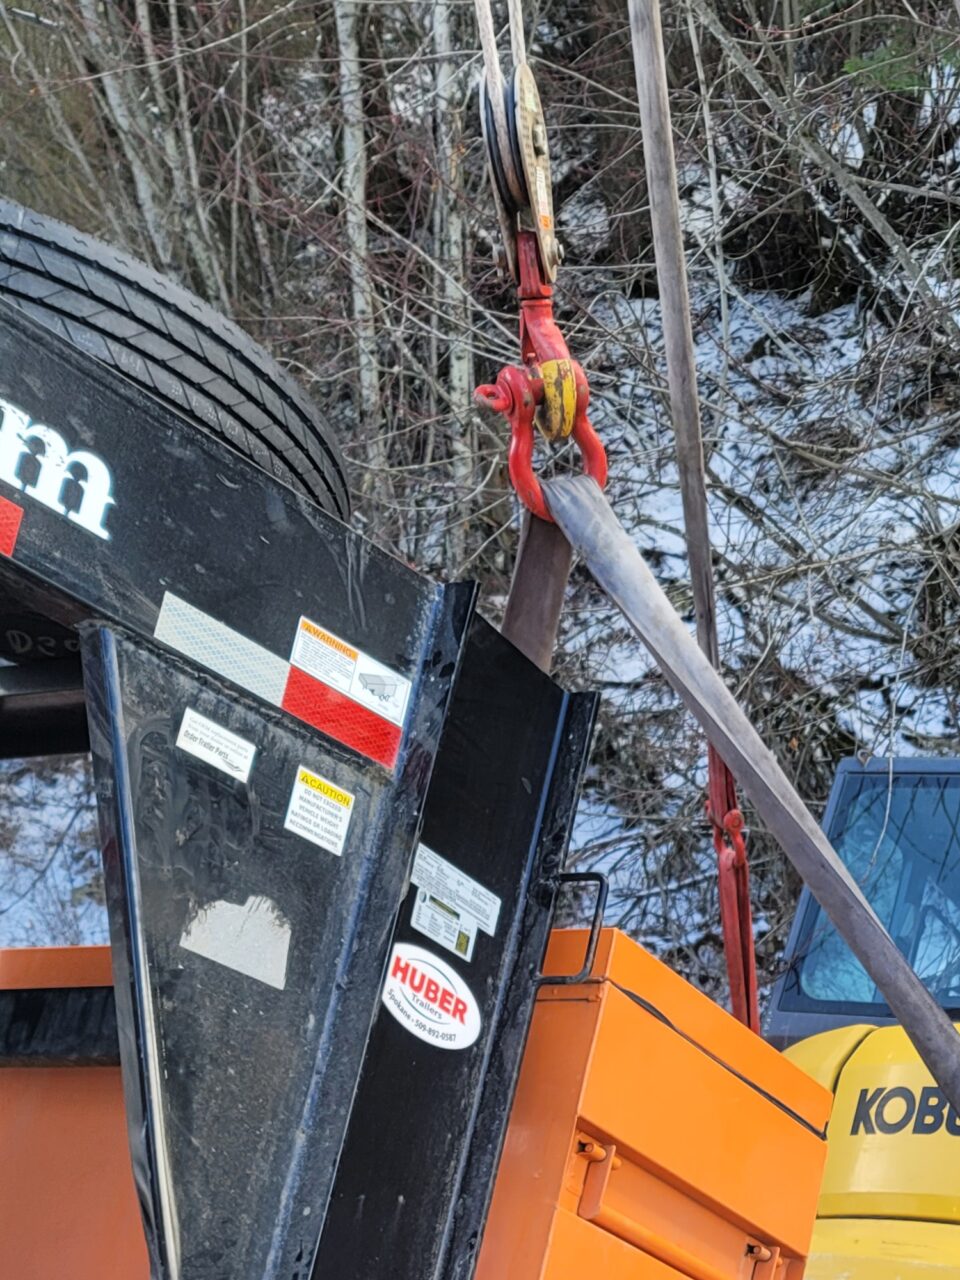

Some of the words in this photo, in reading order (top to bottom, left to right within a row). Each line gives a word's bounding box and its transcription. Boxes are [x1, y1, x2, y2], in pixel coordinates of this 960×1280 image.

[309, 779, 350, 806] CAUTION
[387, 988, 412, 1020] Spokane
[391, 954, 467, 1026] HUBER
[411, 992, 443, 1020] Trailers
